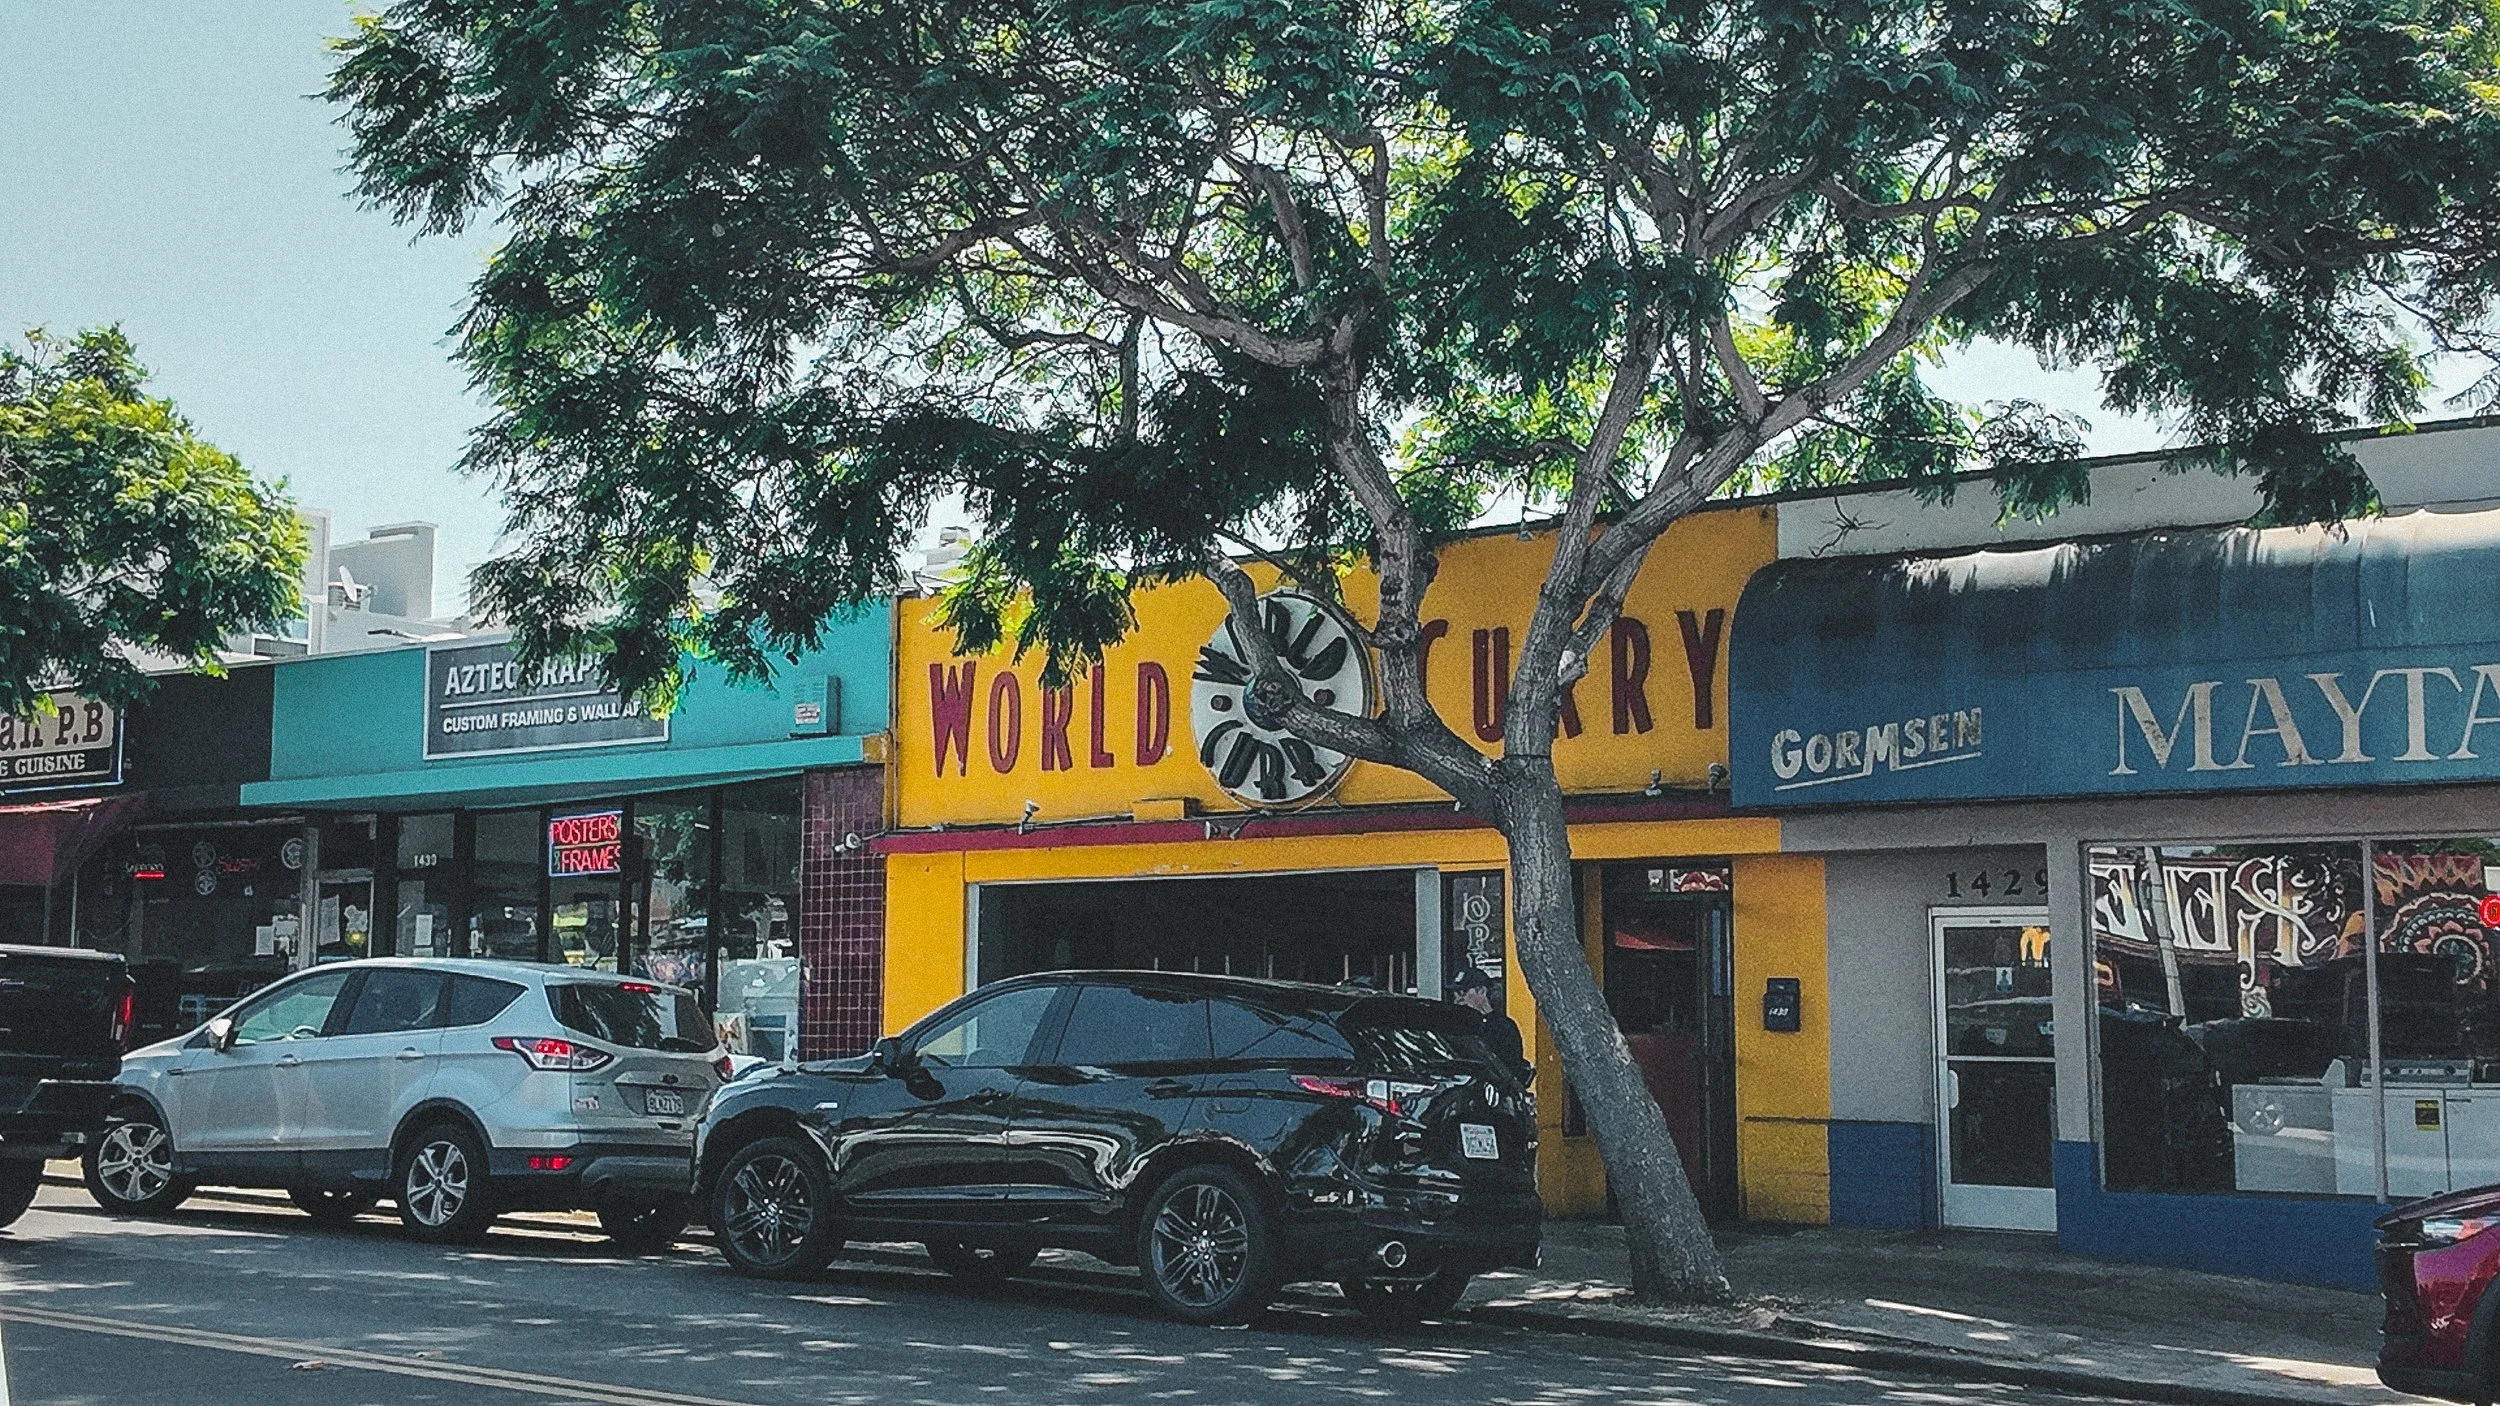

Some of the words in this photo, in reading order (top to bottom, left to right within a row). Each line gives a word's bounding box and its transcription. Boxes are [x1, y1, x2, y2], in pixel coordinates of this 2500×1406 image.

[445, 660, 518, 695] AZTEC
[55, 701, 104, 746] P.B
[443, 713, 498, 733] CUSTOM
[502, 708, 563, 728] FRAMING
[567, 707, 578, 722] &
[581, 702, 620, 720] WALL
[929, 661, 1170, 777] WORLD
[1771, 707, 1982, 780] GORMSEN
[15, 753, 86, 776] CUISINE
[550, 815, 618, 844] POSTERS
[562, 845, 621, 873] FRAMES
[1946, 868, 2048, 898] 1429
